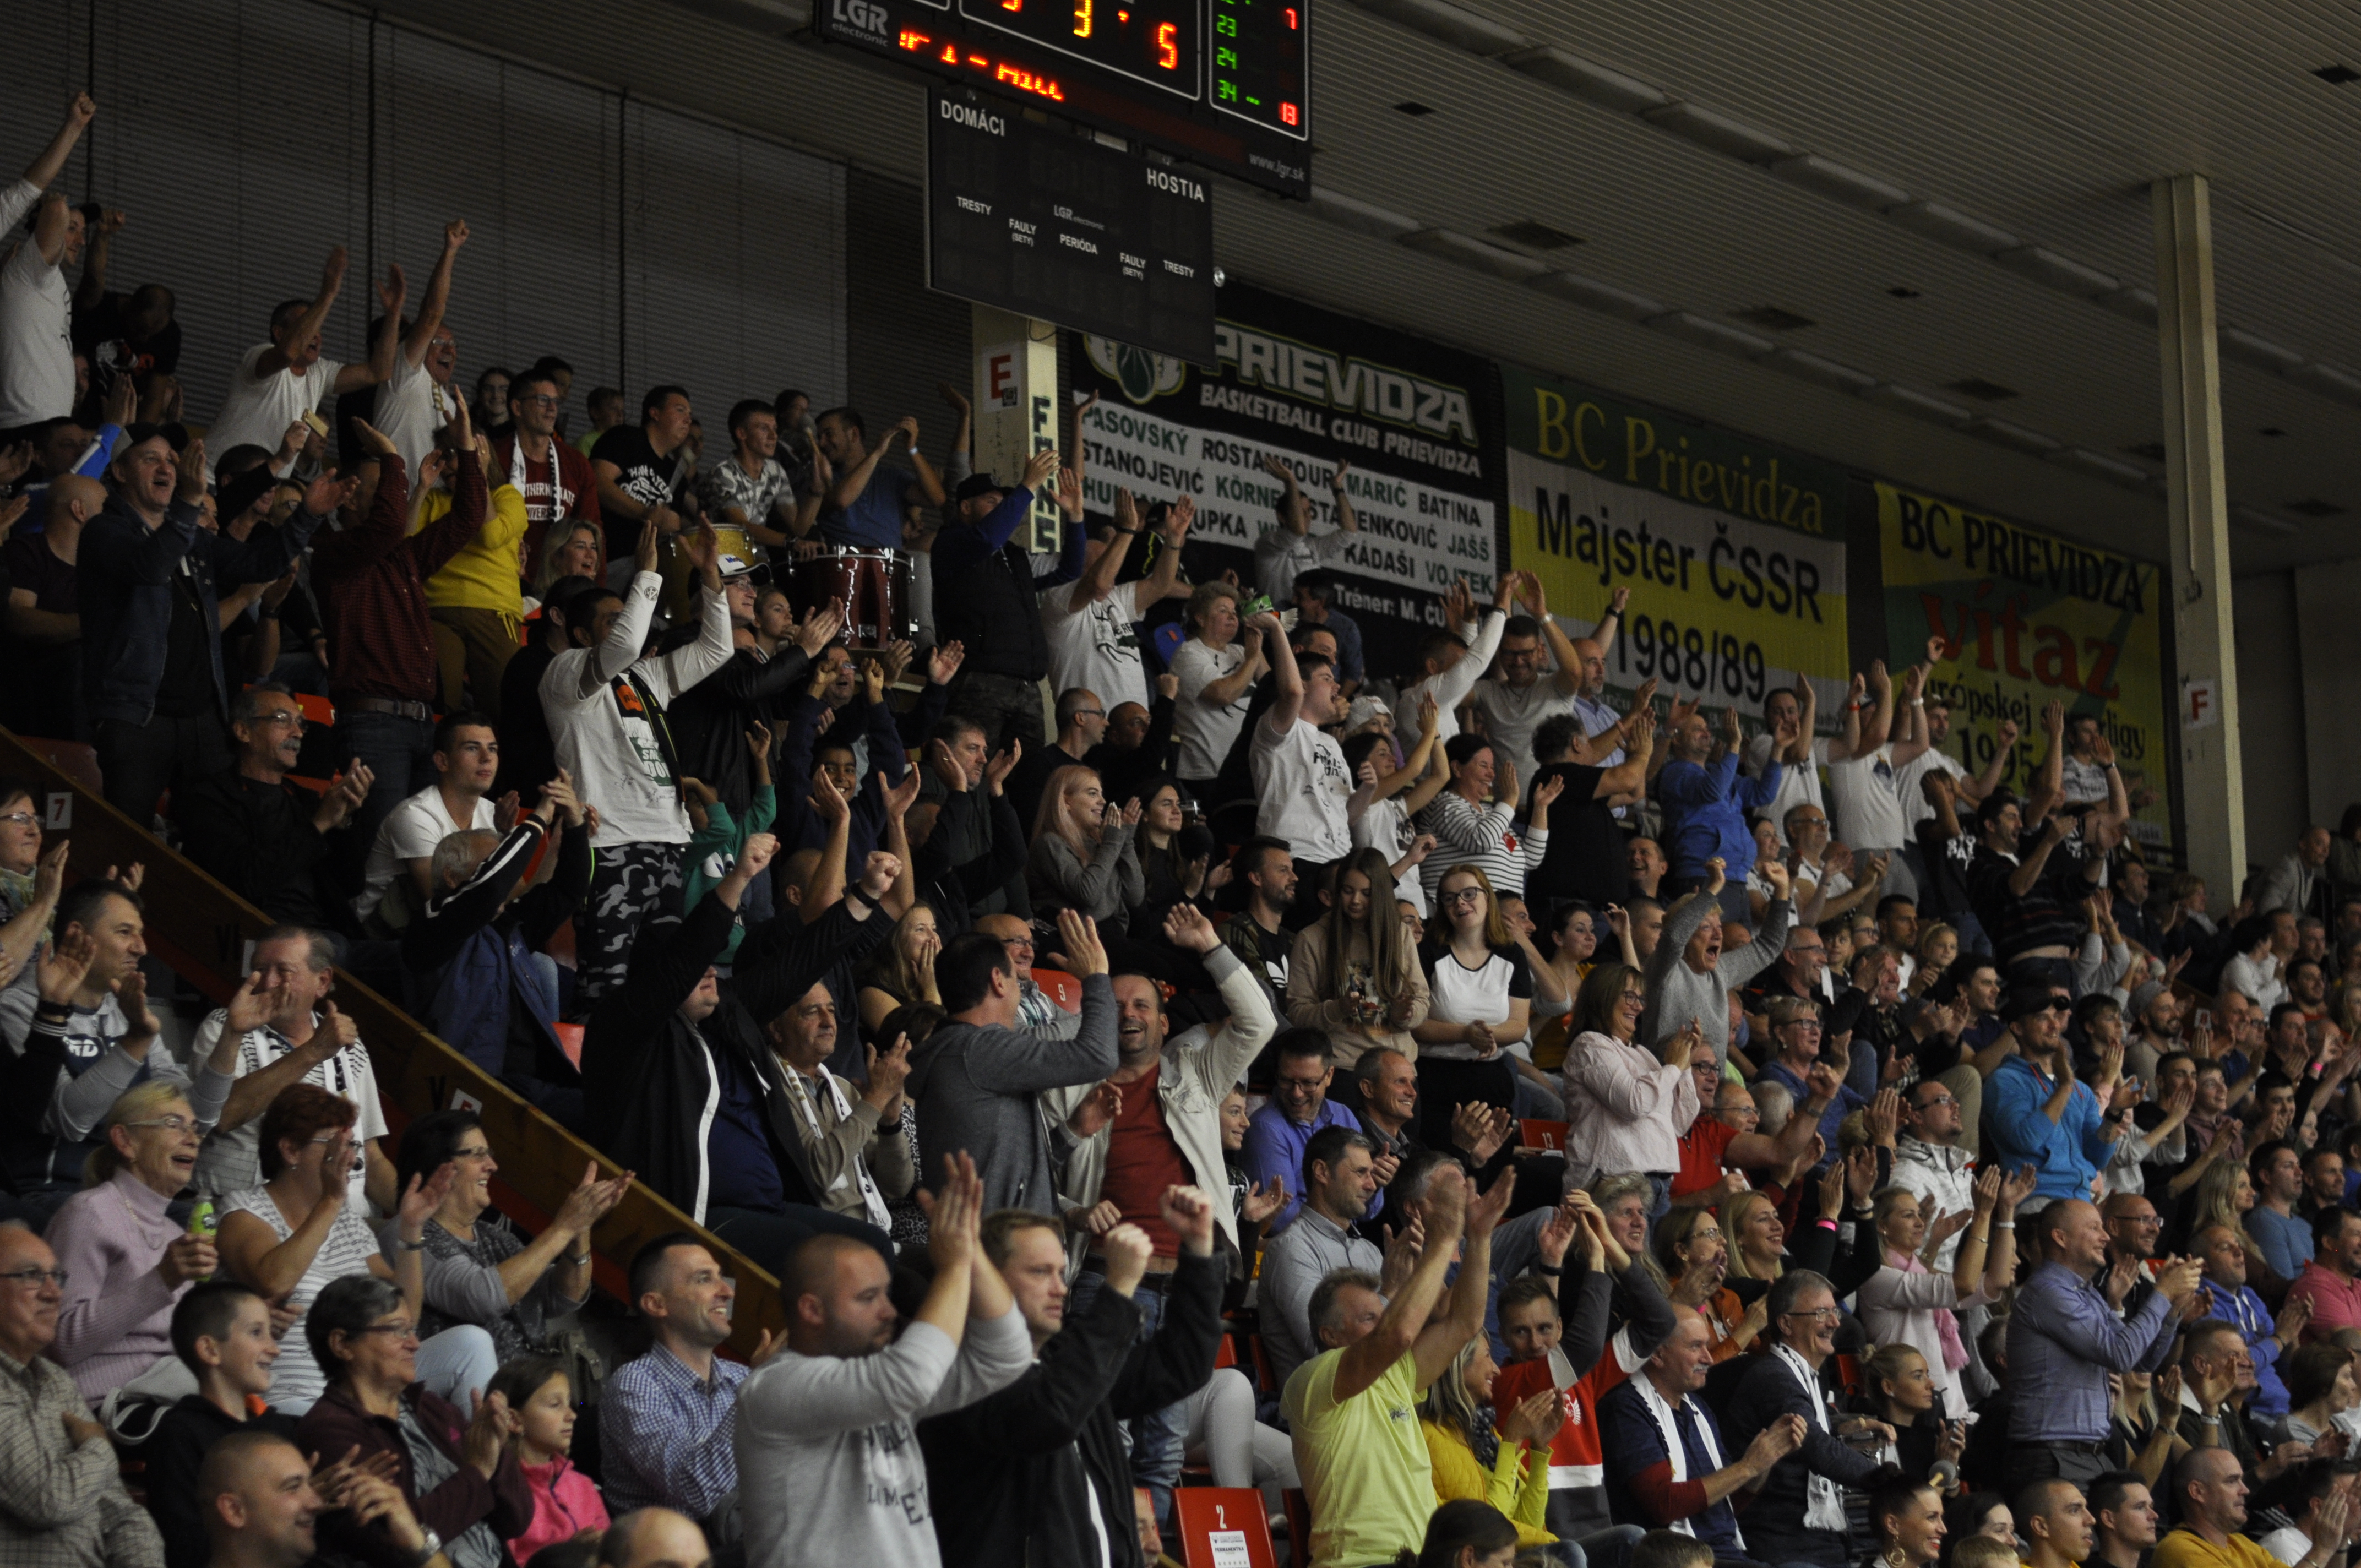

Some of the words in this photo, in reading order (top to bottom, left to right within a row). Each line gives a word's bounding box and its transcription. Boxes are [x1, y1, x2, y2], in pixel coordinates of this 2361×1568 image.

[833, 0, 889, 36] LGR
[1217, 14, 1237, 37] 23
[832, 23, 888, 48] electronic
[1159, 22, 1177, 69] 5
[1217, 47, 1237, 70] 24
[941, 99, 1005, 137] DOMÁCI
[1218, 79, 1237, 102] 34
[1280, 102, 1298, 126] 13
[1249, 153, 1304, 182] www.lgr.sk
[1146, 168, 1205, 203] HOSTIA
[956, 195, 992, 216] TRESTY
[1053, 204, 1073, 221] LGR
[1009, 217, 1037, 236] FAULY
[1012, 232, 1035, 248] (SETY)
[1059, 233, 1098, 255] PERIÓDA
[1119, 252, 1146, 269] FAULY
[1122, 266, 1144, 281] (SETY)
[1162, 259, 1195, 279] TRESTY
[991, 354, 1011, 399] E
[1214, 323, 1476, 444] PRIEVIDZA
[1200, 383, 1326, 437] BASKETBALL
[1330, 418, 1379, 449] CLUB
[1384, 432, 1482, 479] PRIEVIDZA
[1535, 386, 1607, 472] BC
[1625, 416, 1824, 533] Prievidza
[1083, 438, 1204, 494] STANOJEVIĆ
[1447, 532, 1490, 562] JAŠŠ
[1418, 492, 1482, 527] BATINA
[1345, 540, 1415, 579] KÁDAŠI
[1536, 486, 1694, 591] Majster
[1709, 520, 1823, 624] ČSSR
[1897, 493, 1952, 559] BC
[1962, 514, 2144, 614] PRIEVIDZA
[1333, 582, 1396, 617] Tréner:
[1400, 598, 1421, 623] M.
[1615, 612, 1766, 704] 1988/89
[2191, 689, 2208, 720] F
[54, 798, 66, 821] 7
[215, 923, 240, 963] VI
[1057, 983, 1067, 1001] 9
[1542, 1131, 1554, 1149] 13
[1215, 1504, 1228, 1529] 2
